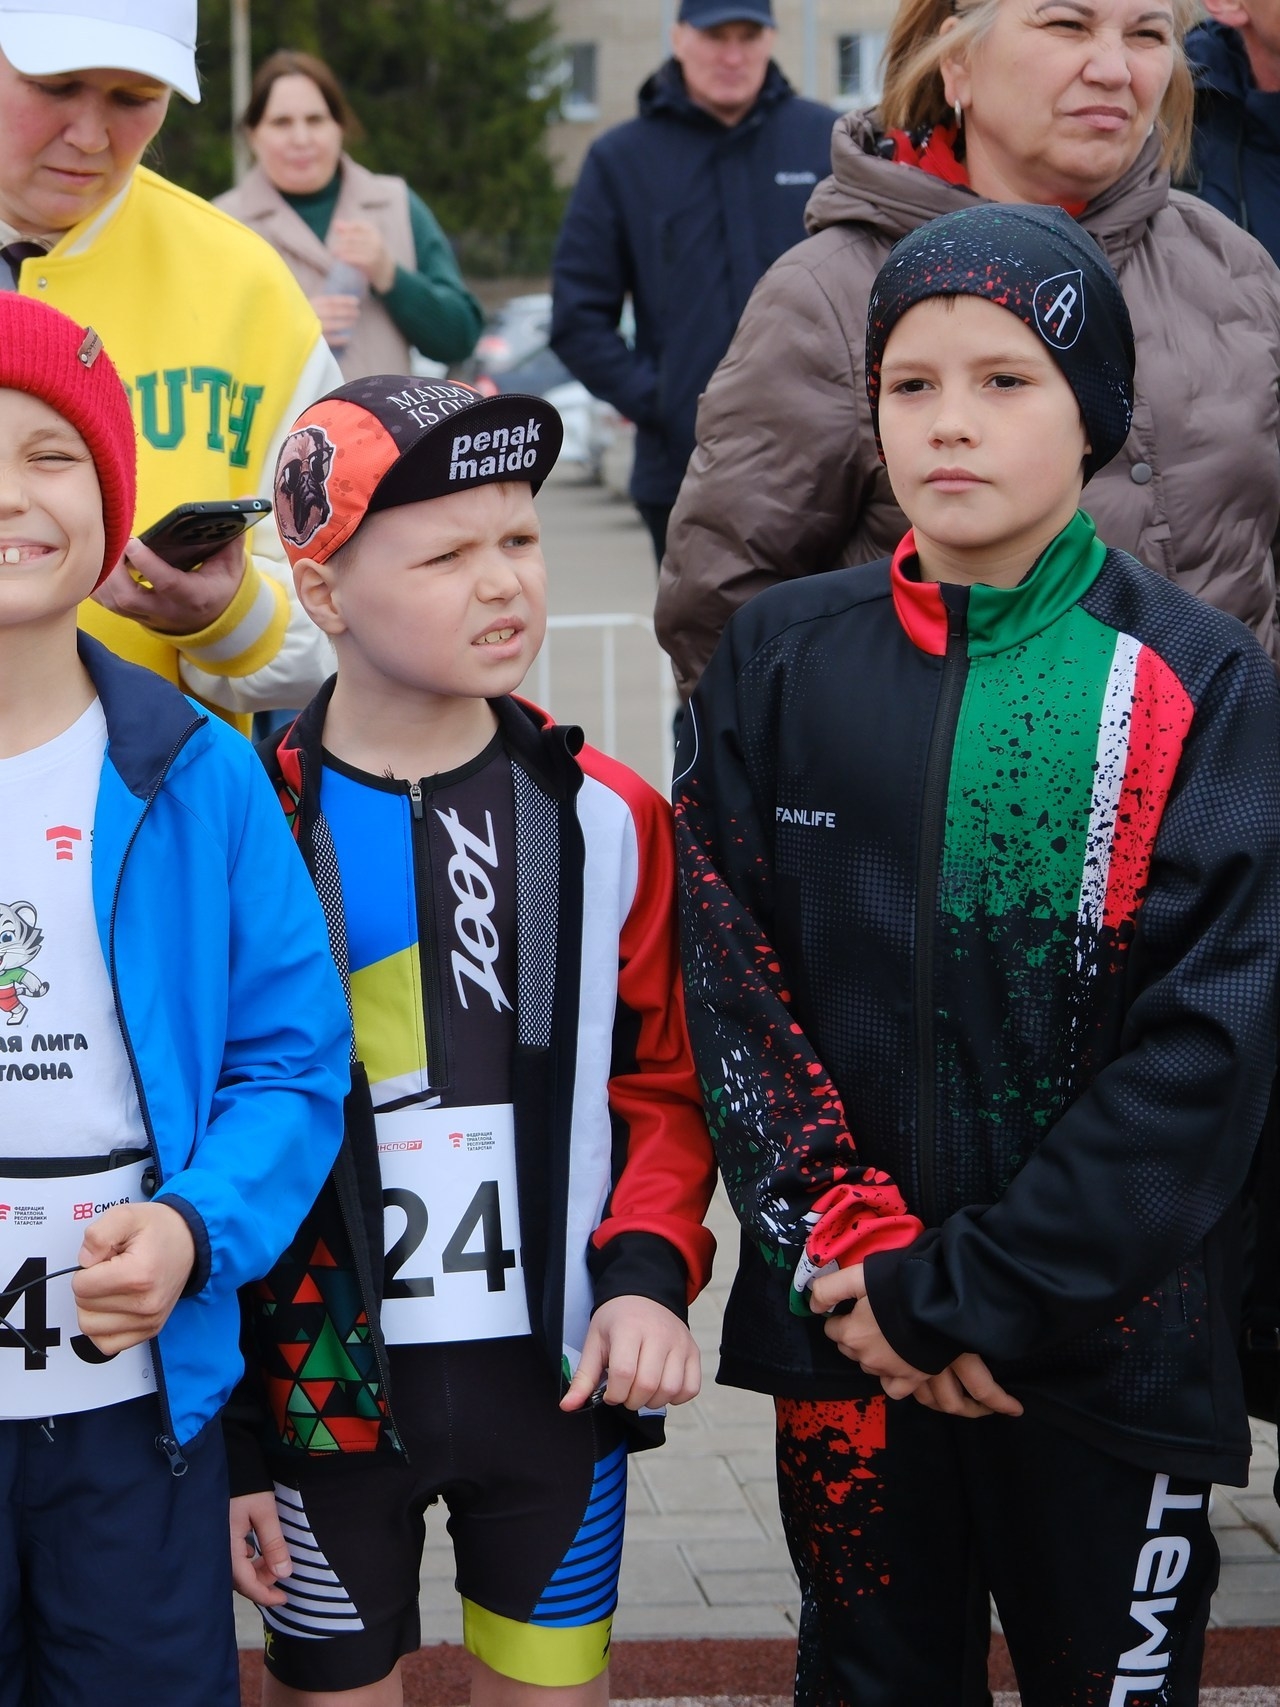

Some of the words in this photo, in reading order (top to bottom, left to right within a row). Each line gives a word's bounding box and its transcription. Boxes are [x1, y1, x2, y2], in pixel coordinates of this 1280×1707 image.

[386, 386, 474, 410] MAIDO
[123, 366, 265, 468] UTH
[407, 405, 439, 428] IS
[451, 418, 542, 461] penak
[449, 445, 537, 480] maido
[775, 806, 836, 828] FANLIFE
[31, 1033, 89, 1052] ЛИГА
[382, 1180, 524, 1299] 24
